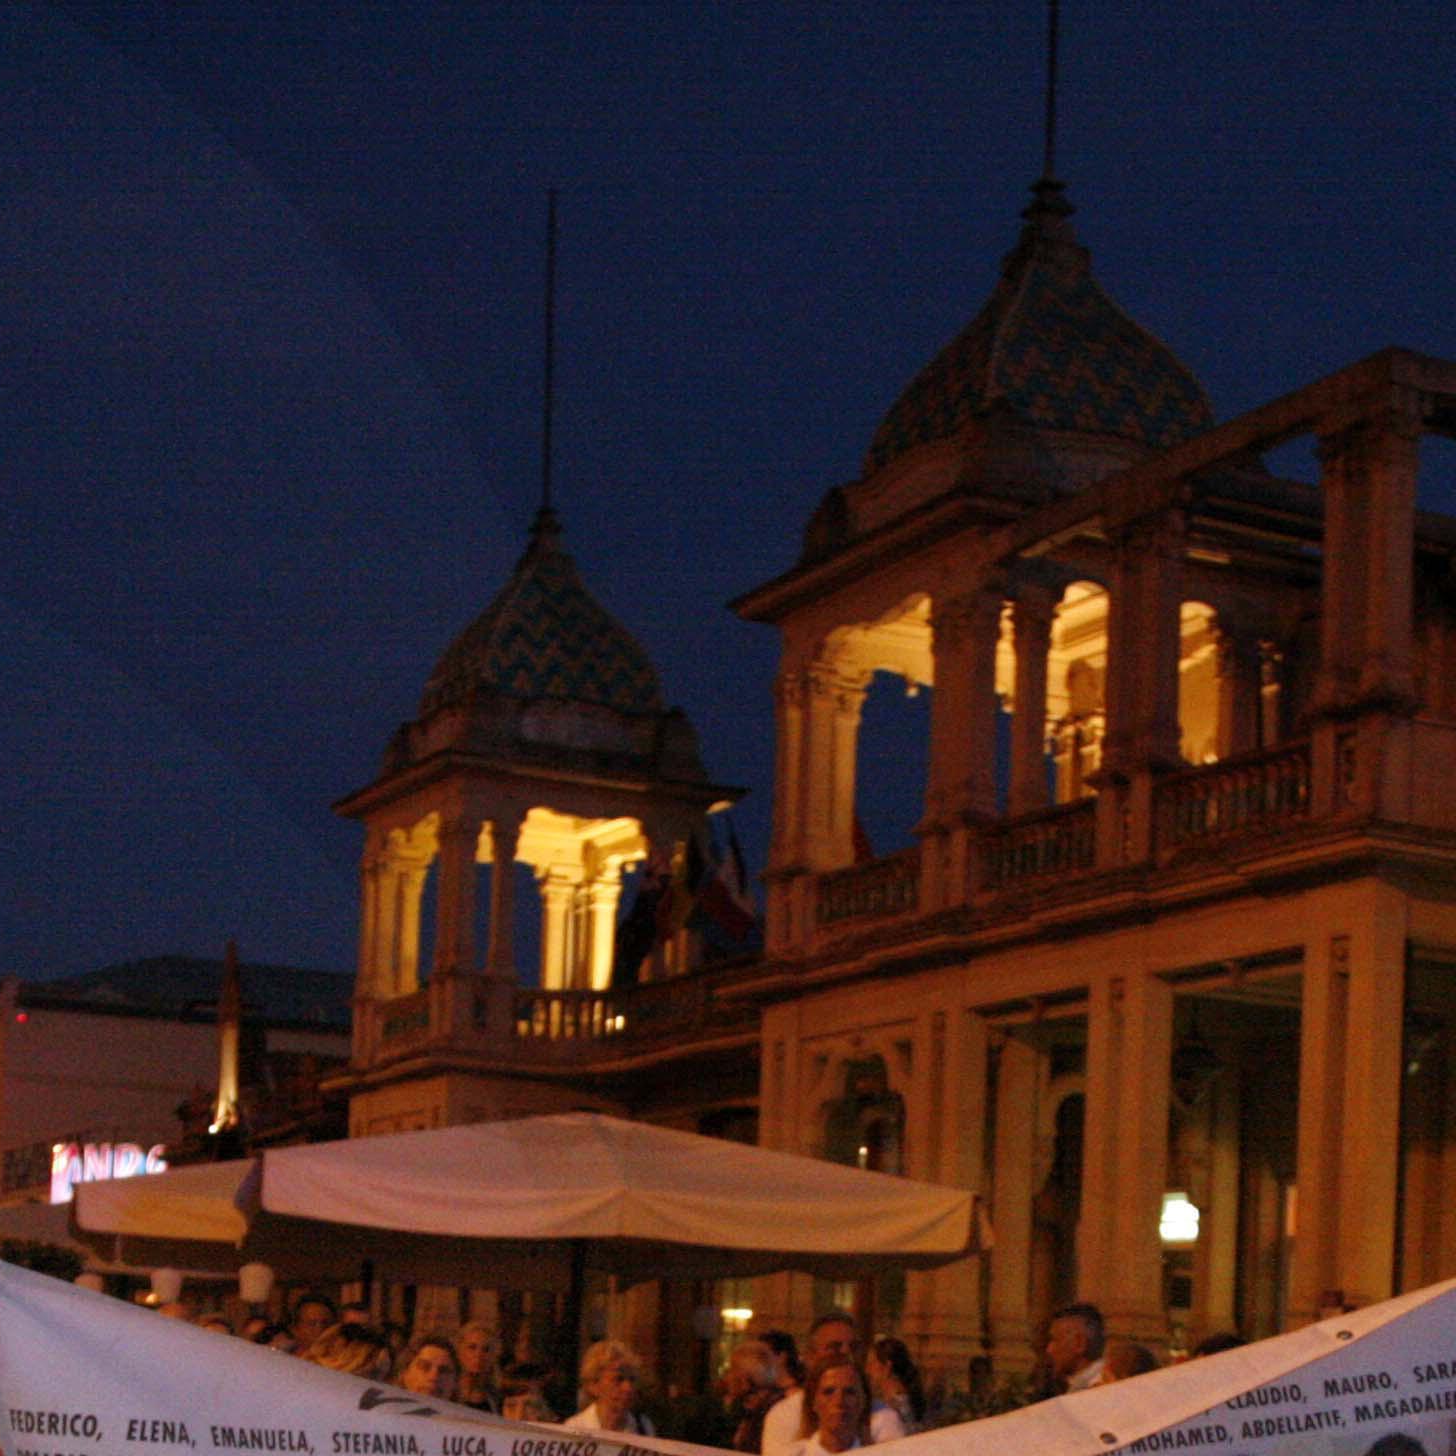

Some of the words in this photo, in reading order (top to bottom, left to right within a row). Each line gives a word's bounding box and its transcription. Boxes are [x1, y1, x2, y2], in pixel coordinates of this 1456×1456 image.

[1225, 1386, 1307, 1412] CLAUDIO,
[1323, 1371, 1398, 1397] MAURO,
[9, 1408, 103, 1442] FEDERICO,
[126, 1418, 196, 1447] ELENA,
[210, 1425, 314, 1456] EMANUELA,
[1130, 1424, 1234, 1455] MOHAMED,
[1242, 1412, 1347, 1439] ABDELLATIF,
